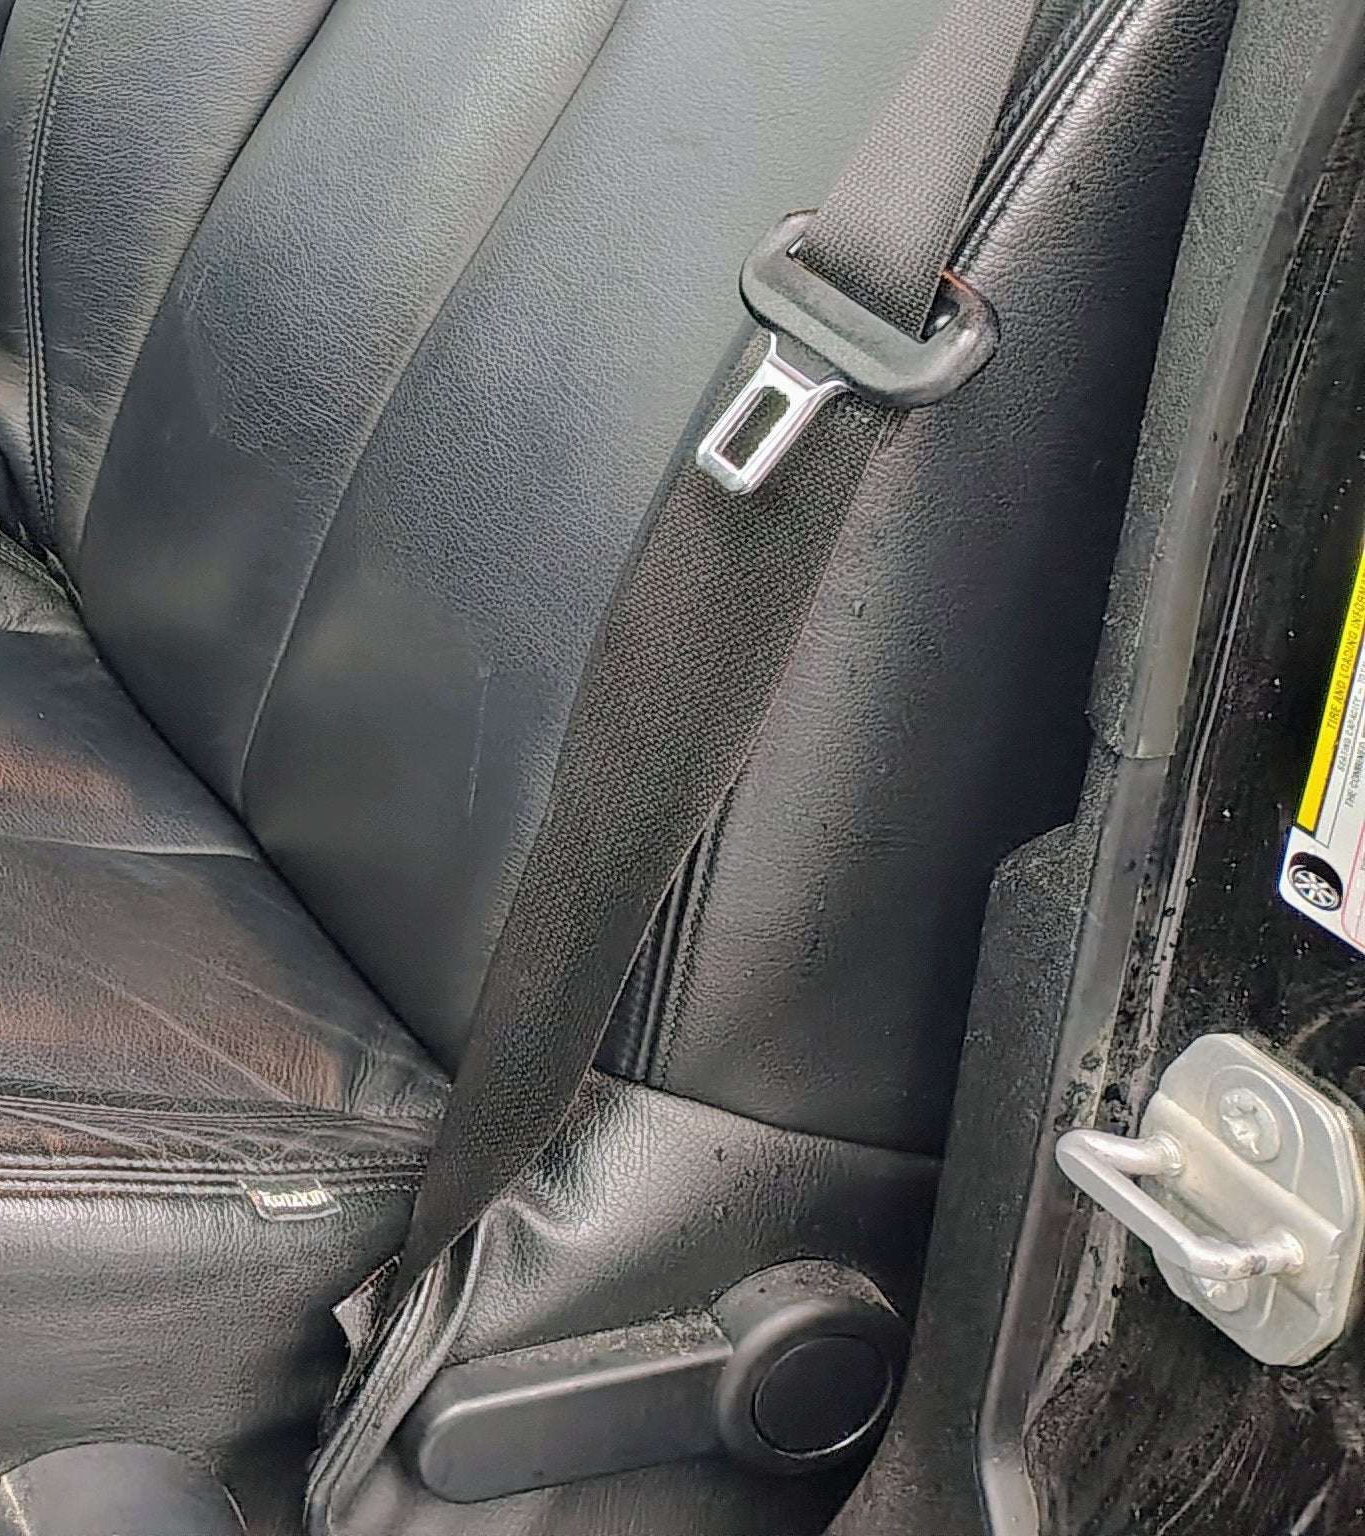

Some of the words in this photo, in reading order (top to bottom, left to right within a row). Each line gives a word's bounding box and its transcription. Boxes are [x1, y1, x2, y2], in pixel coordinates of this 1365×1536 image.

[1339, 631, 1358, 679] LOADING
[1333, 679, 1346, 705] AND
[1327, 703, 1340, 731] TIRE
